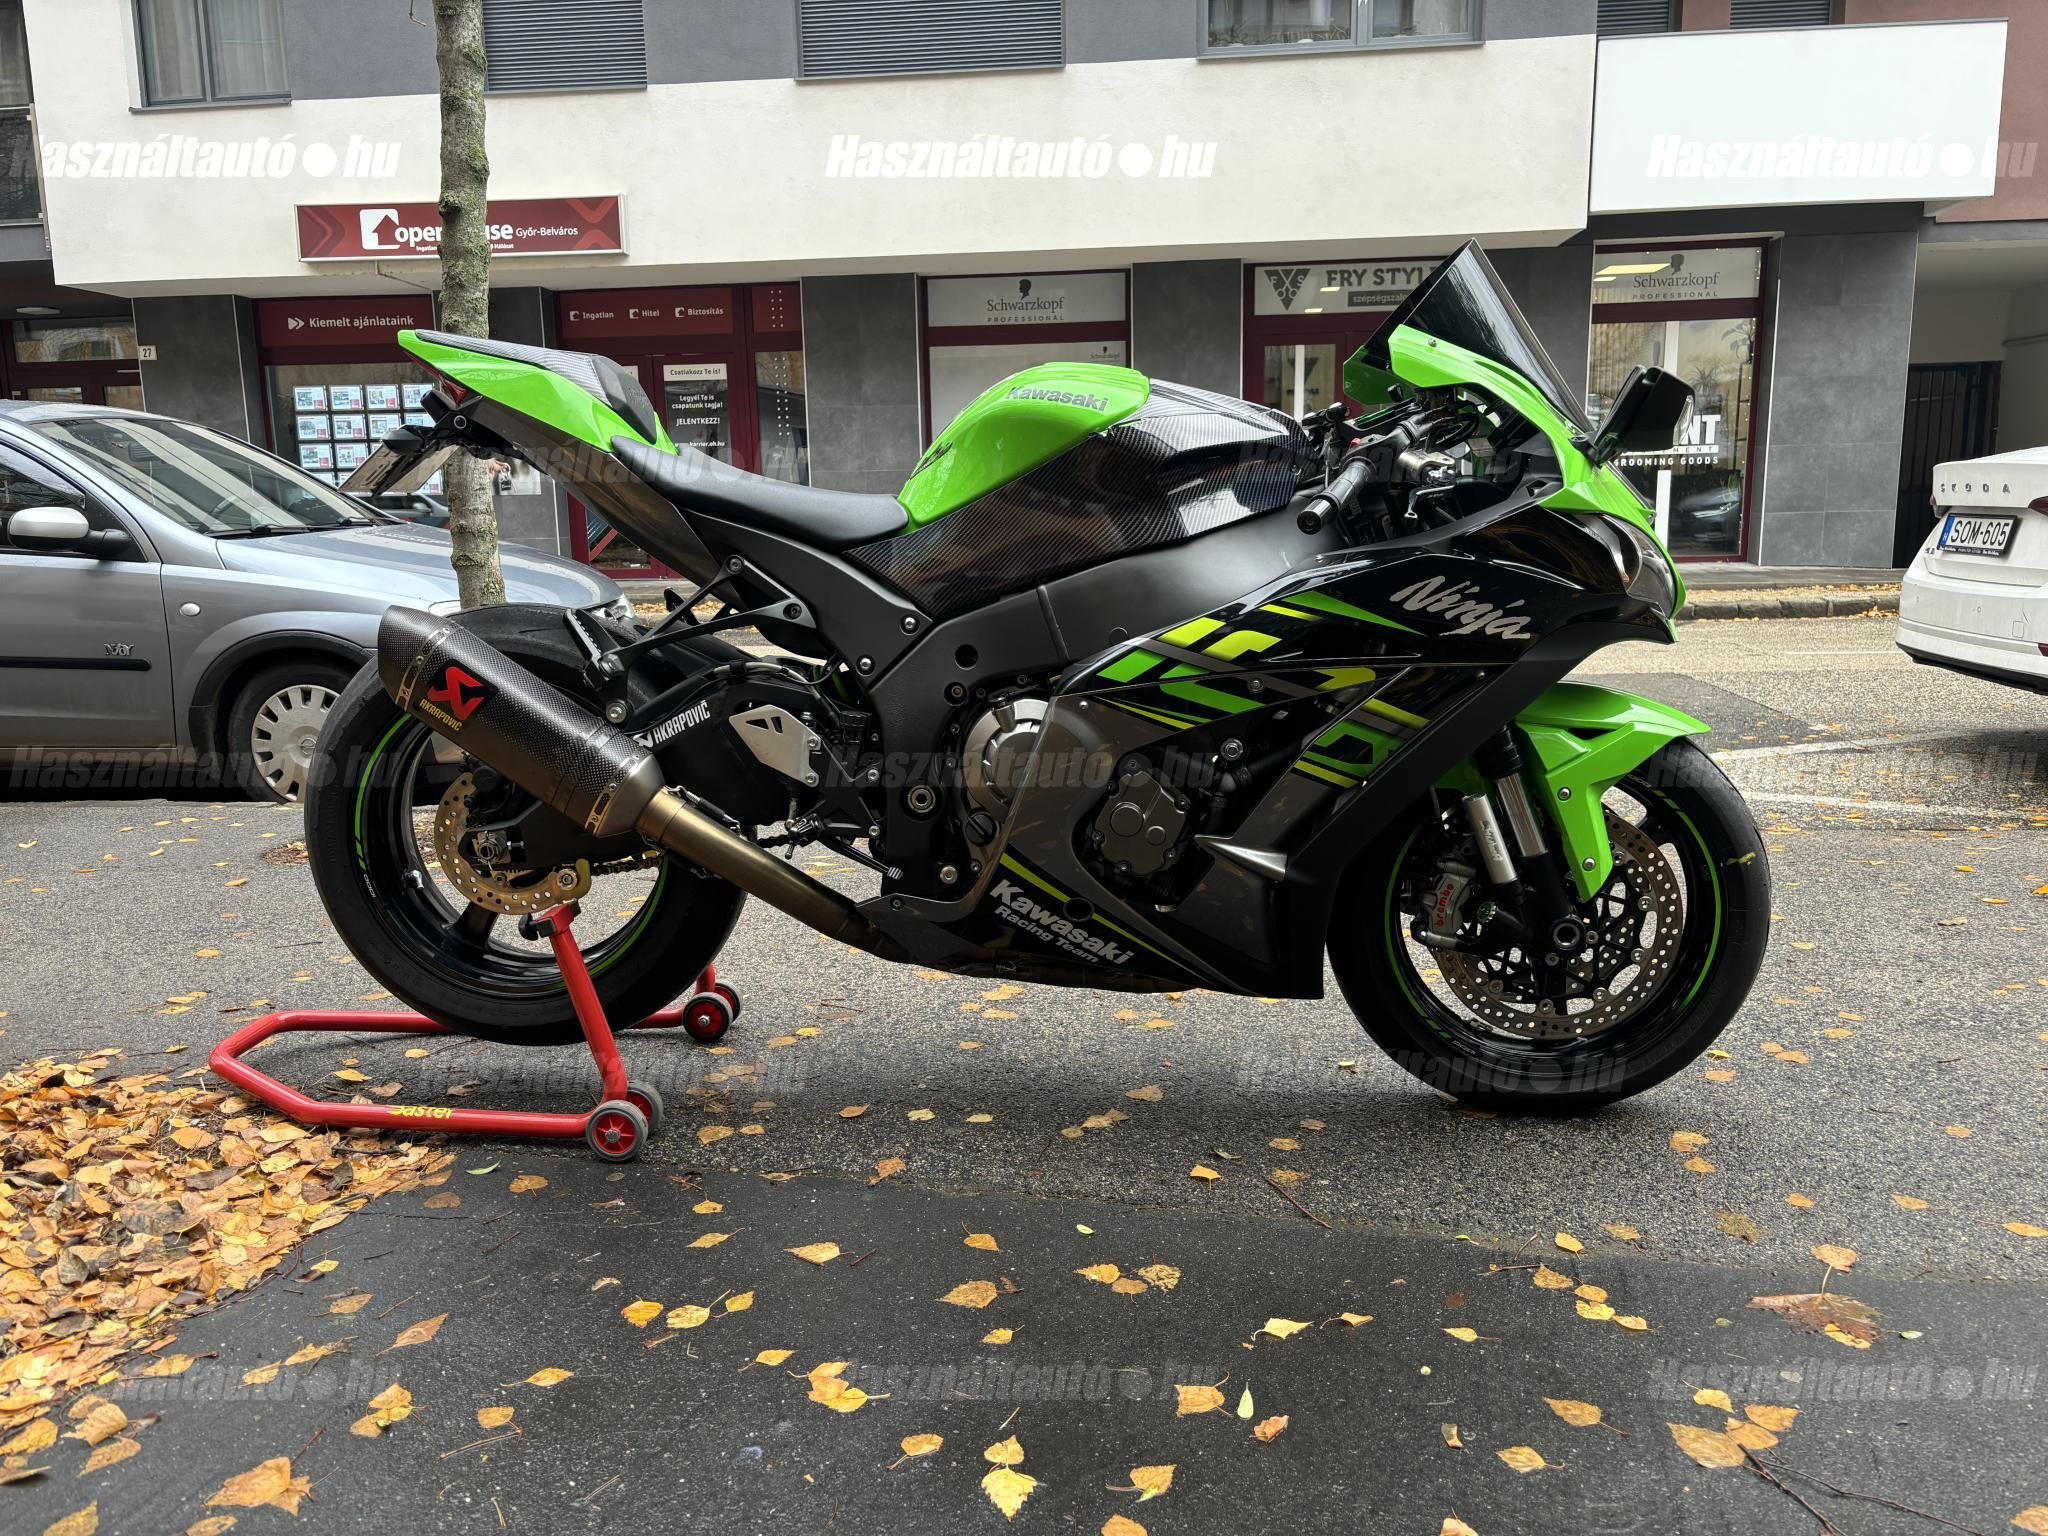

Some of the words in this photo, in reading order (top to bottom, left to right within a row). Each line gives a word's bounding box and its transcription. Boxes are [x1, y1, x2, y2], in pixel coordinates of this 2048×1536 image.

[515, 226, 579, 238] Győr-Belváros
[1326, 268, 1367, 287] FRY
[1633, 272, 1720, 290] Schwarzkopf
[1632, 291, 1718, 300] PROFESSIONAL
[582, 311, 614, 320] Ingatlan
[687, 307, 724, 316] Biztosítás
[987, 296, 1065, 314] Schwarzkopf
[309, 317, 351, 329] Kiemelt
[353, 315, 414, 328] ajánlataink
[987, 315, 1065, 323] PROFESSIONAL
[142, 347, 152, 358] 27
[1006, 386, 1109, 412] Kawasaki
[676, 417, 721, 427] JELENTKEZZ!
[1680, 456, 1719, 466] GOODS
[1950, 520, 2010, 547] SOM-605
[1389, 575, 1532, 640] Ninja
[1434, 883, 1455, 928] brembo
[989, 879, 1135, 965] Kawasaki
[994, 904, 1055, 942] Racing
[1055, 936, 1099, 963] Team
